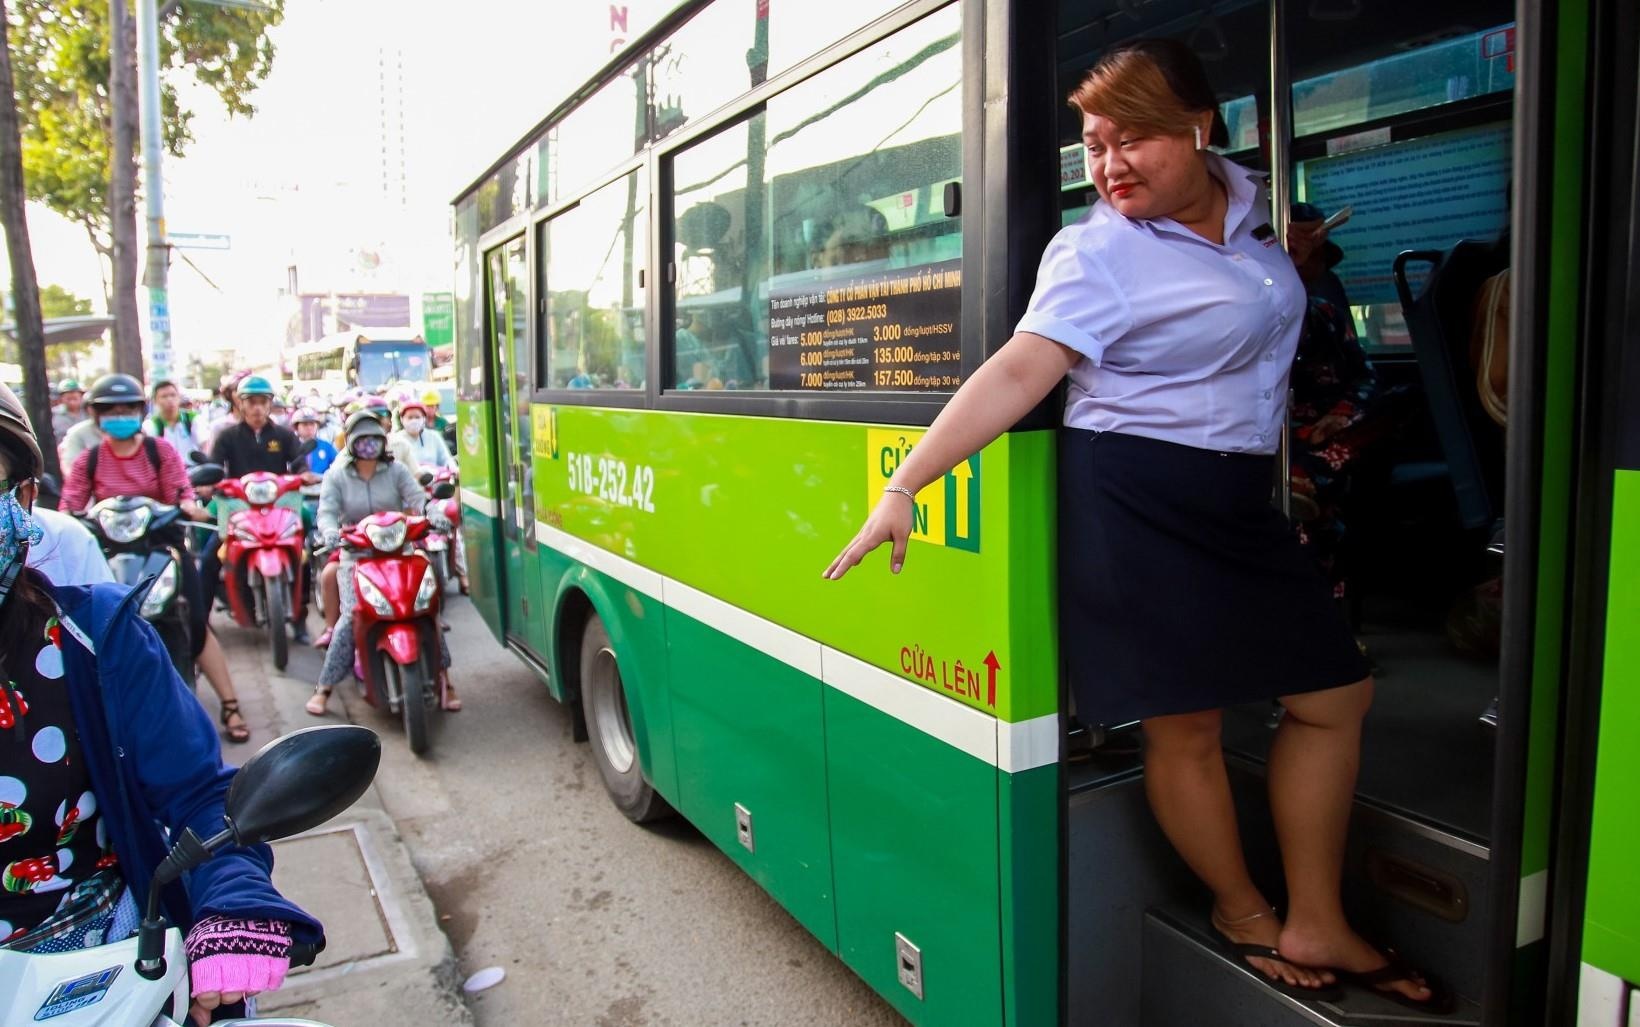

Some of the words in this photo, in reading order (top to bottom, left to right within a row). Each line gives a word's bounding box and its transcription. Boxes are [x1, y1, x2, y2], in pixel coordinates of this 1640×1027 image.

[827, 309, 845, 327] (028)
[847, 304, 887, 321] 3922.5033
[800, 331, 822, 346] 5.000
[873, 324, 900, 341] 3.000
[800, 351, 822, 366] 6.000
[873, 346, 914, 364] 135.000
[942, 351, 951, 360] 30
[800, 372, 822, 387] 7.000
[873, 369, 914, 386] 157.500
[942, 376, 951, 385] 30
[567, 452, 655, 513] 51B-252.42
[901, 643, 937, 684] CỬA
[943, 659, 980, 700] LÊN
